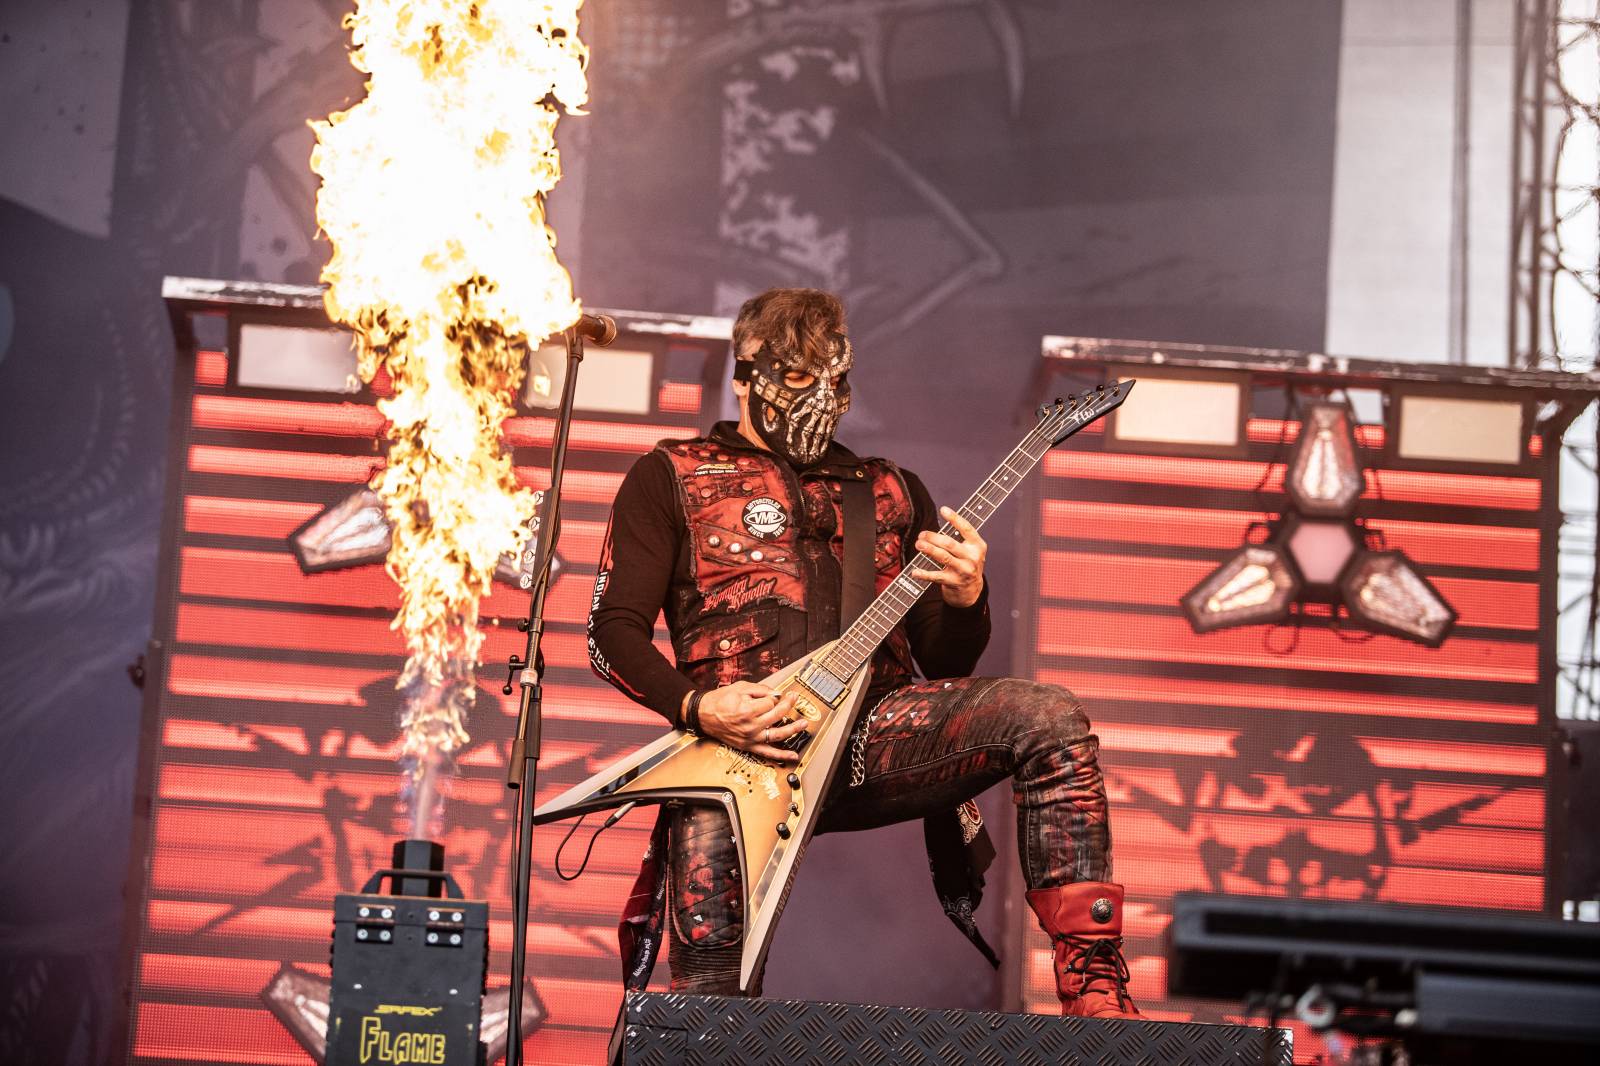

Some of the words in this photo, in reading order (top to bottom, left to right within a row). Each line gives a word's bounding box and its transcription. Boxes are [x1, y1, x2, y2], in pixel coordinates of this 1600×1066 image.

[754, 511, 779, 525] VMP
[747, 526, 765, 539] SINCE
[591, 571, 609, 612] INDIAN
[360, 1016, 446, 1065] FLAME
